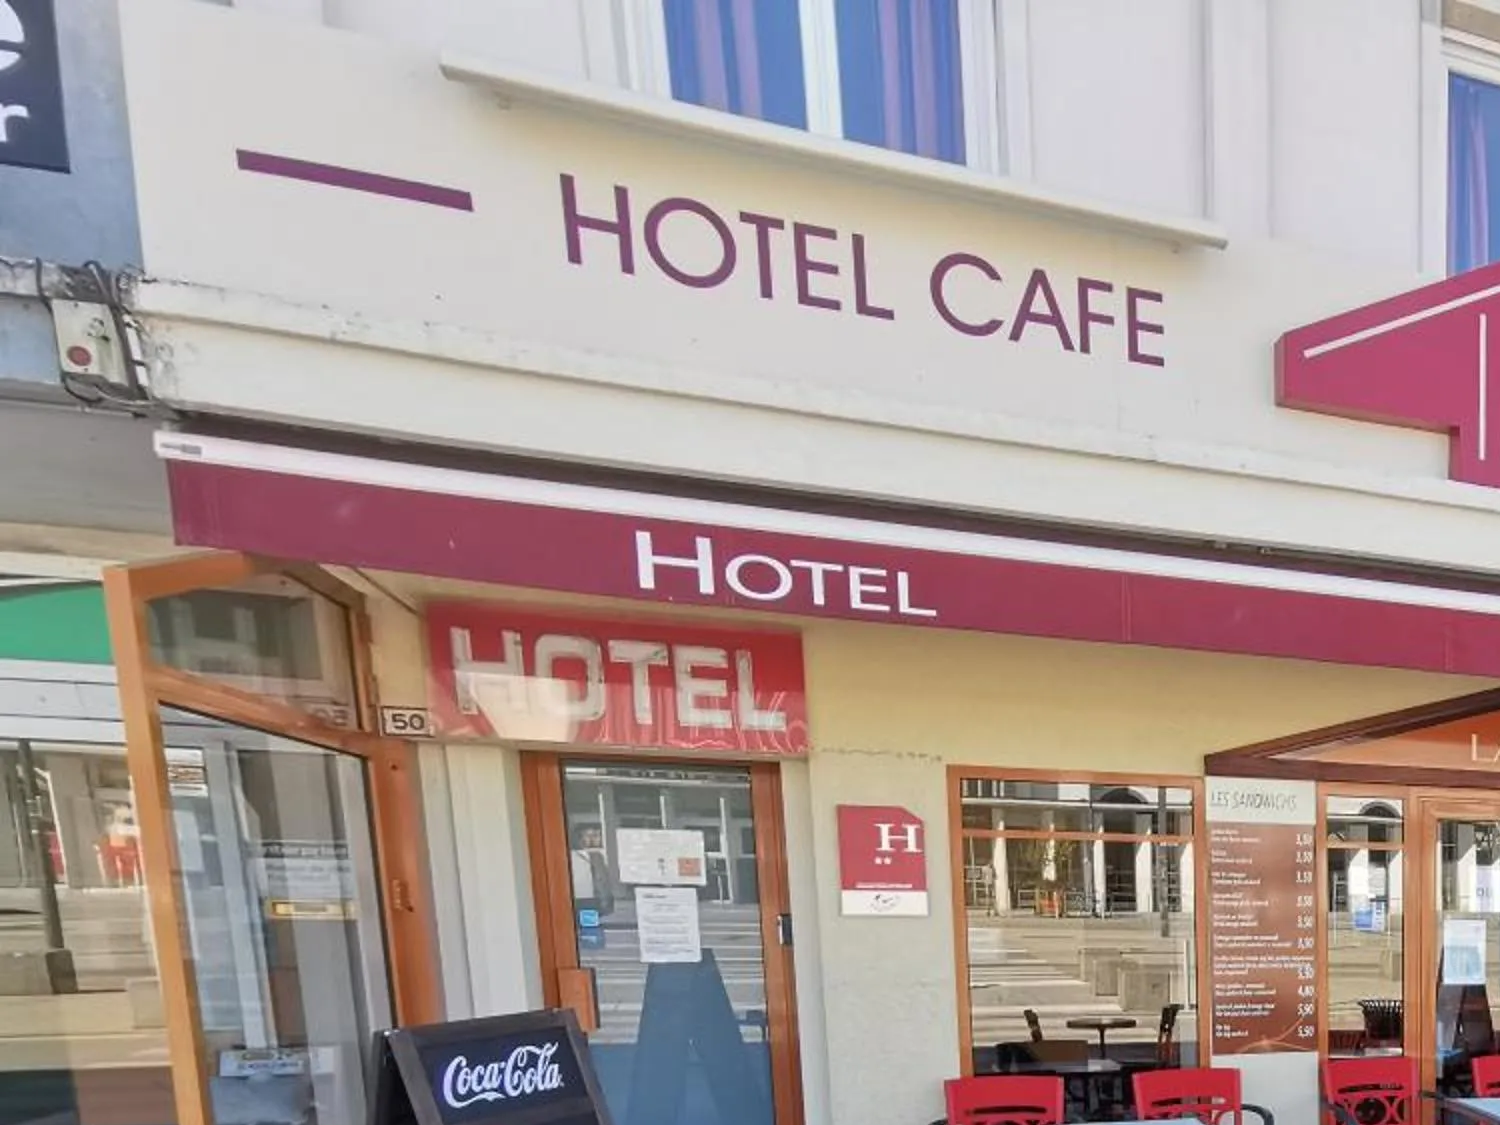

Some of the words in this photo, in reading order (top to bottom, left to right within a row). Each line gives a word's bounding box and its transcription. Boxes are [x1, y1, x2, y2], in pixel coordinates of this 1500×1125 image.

[559, 172, 895, 321] HOTEL
[929, 252, 1165, 367] CAFE
[449, 626, 788, 733] HOTEL
[392, 714, 425, 732] 50
[873, 823, 924, 853] H
[443, 1041, 561, 1109] Coca-Cola
